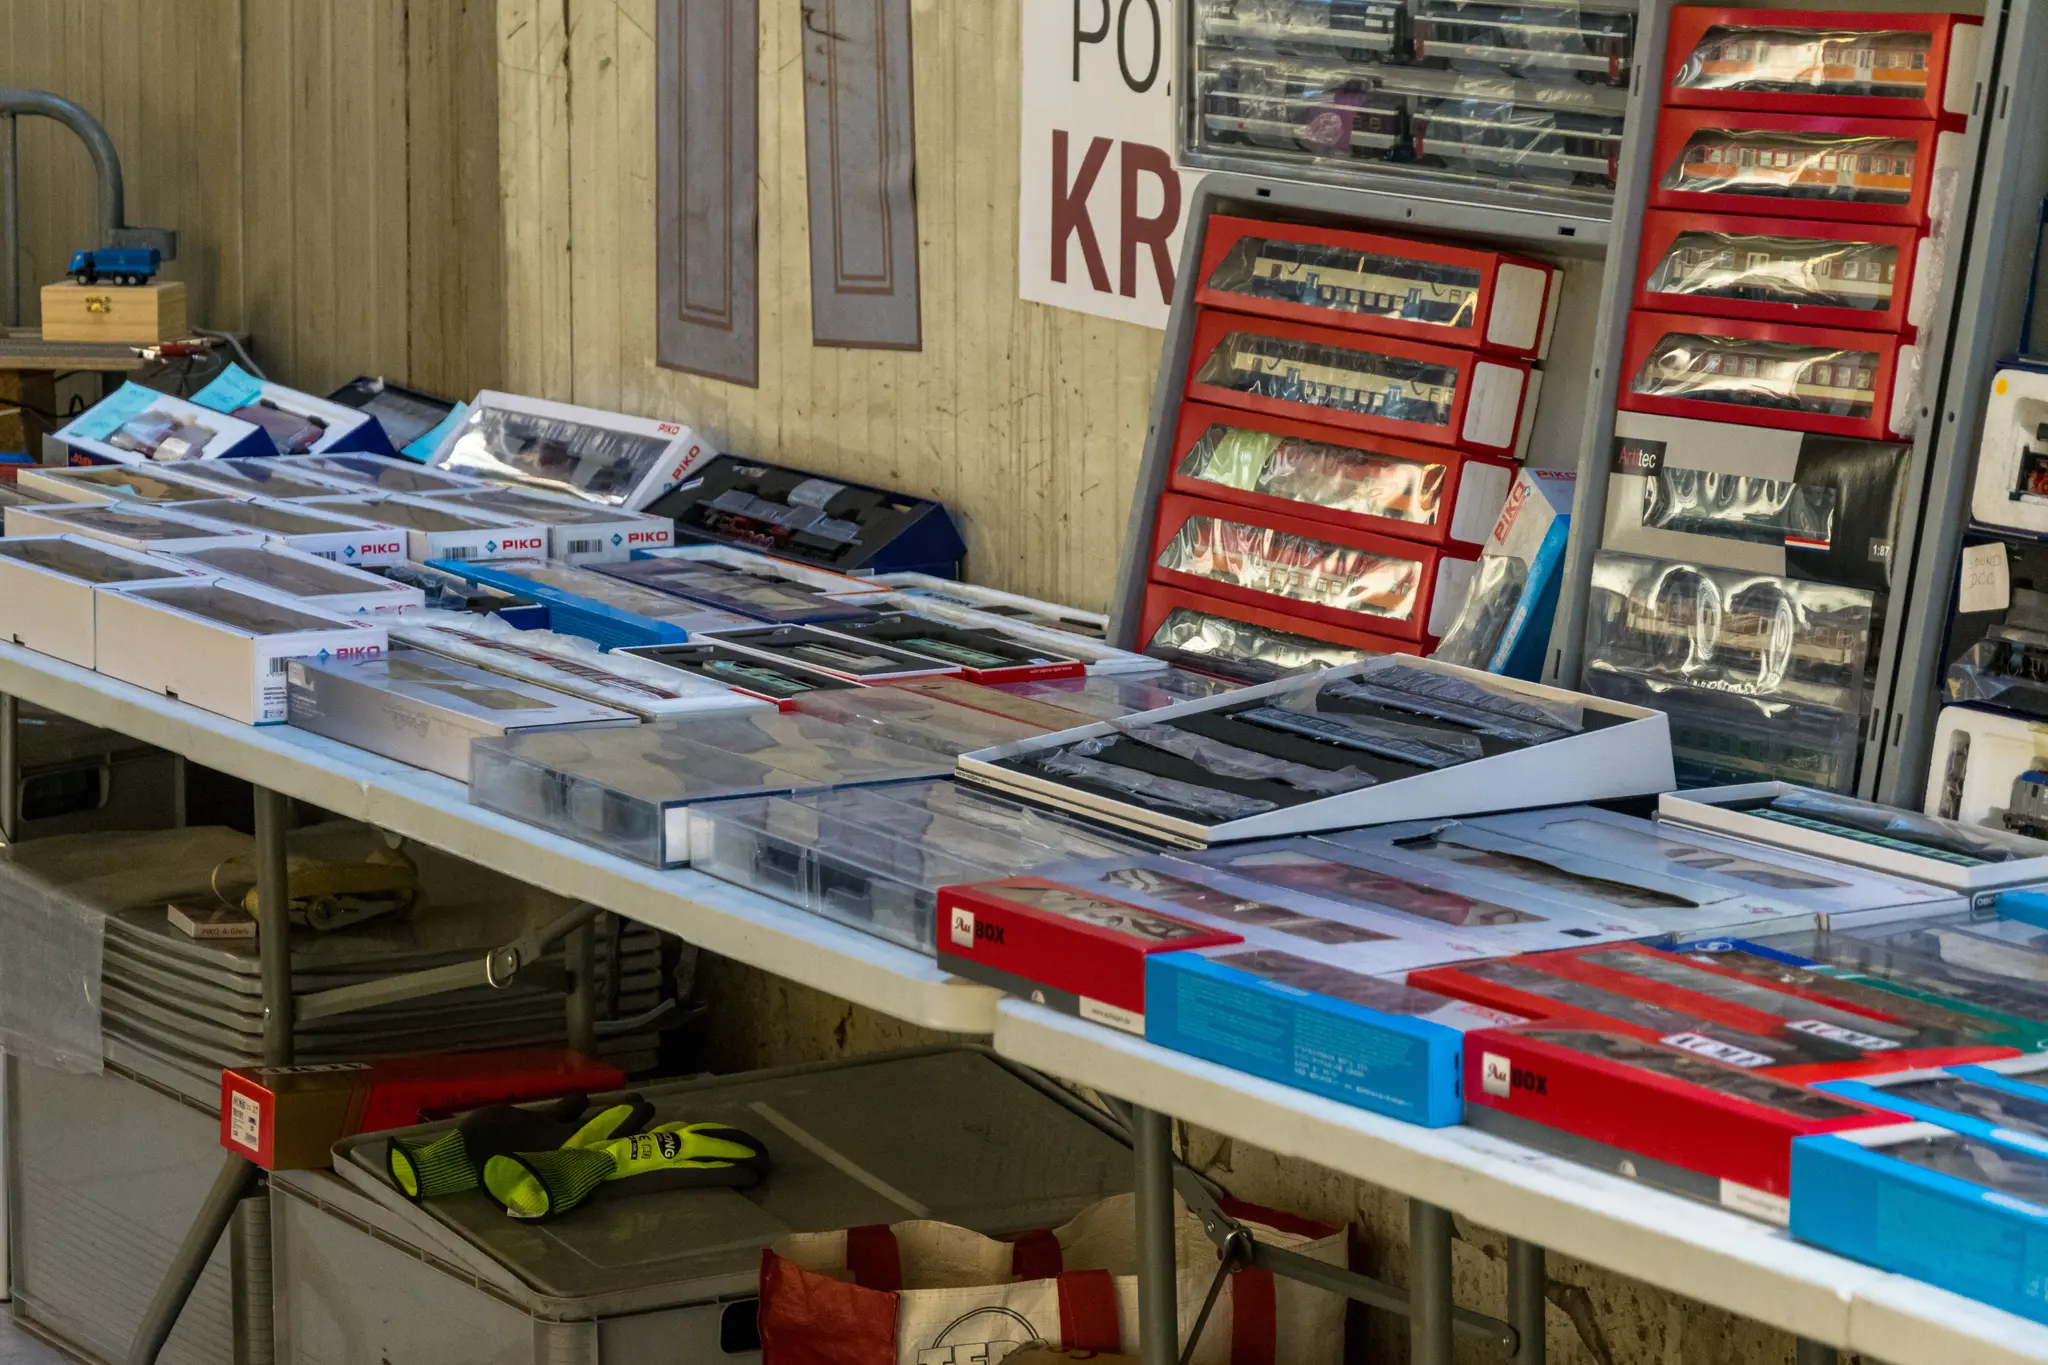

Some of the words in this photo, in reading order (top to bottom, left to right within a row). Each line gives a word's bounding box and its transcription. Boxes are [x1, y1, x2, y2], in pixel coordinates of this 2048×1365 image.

[1073, 0, 1171, 96] PO
[657, 423, 680, 435] PIKO
[672, 445, 701, 480] PIKO
[1618, 447, 1657, 469] Artitec
[1494, 481, 1525, 544] PIKO
[360, 542, 400, 555] PIKO
[502, 538, 542, 550] PIKO
[627, 531, 669, 544] PIKO
[1872, 544, 1891, 557] 1:87
[976, 920, 1004, 944] BOX
[1512, 1068, 1547, 1096] BOX
